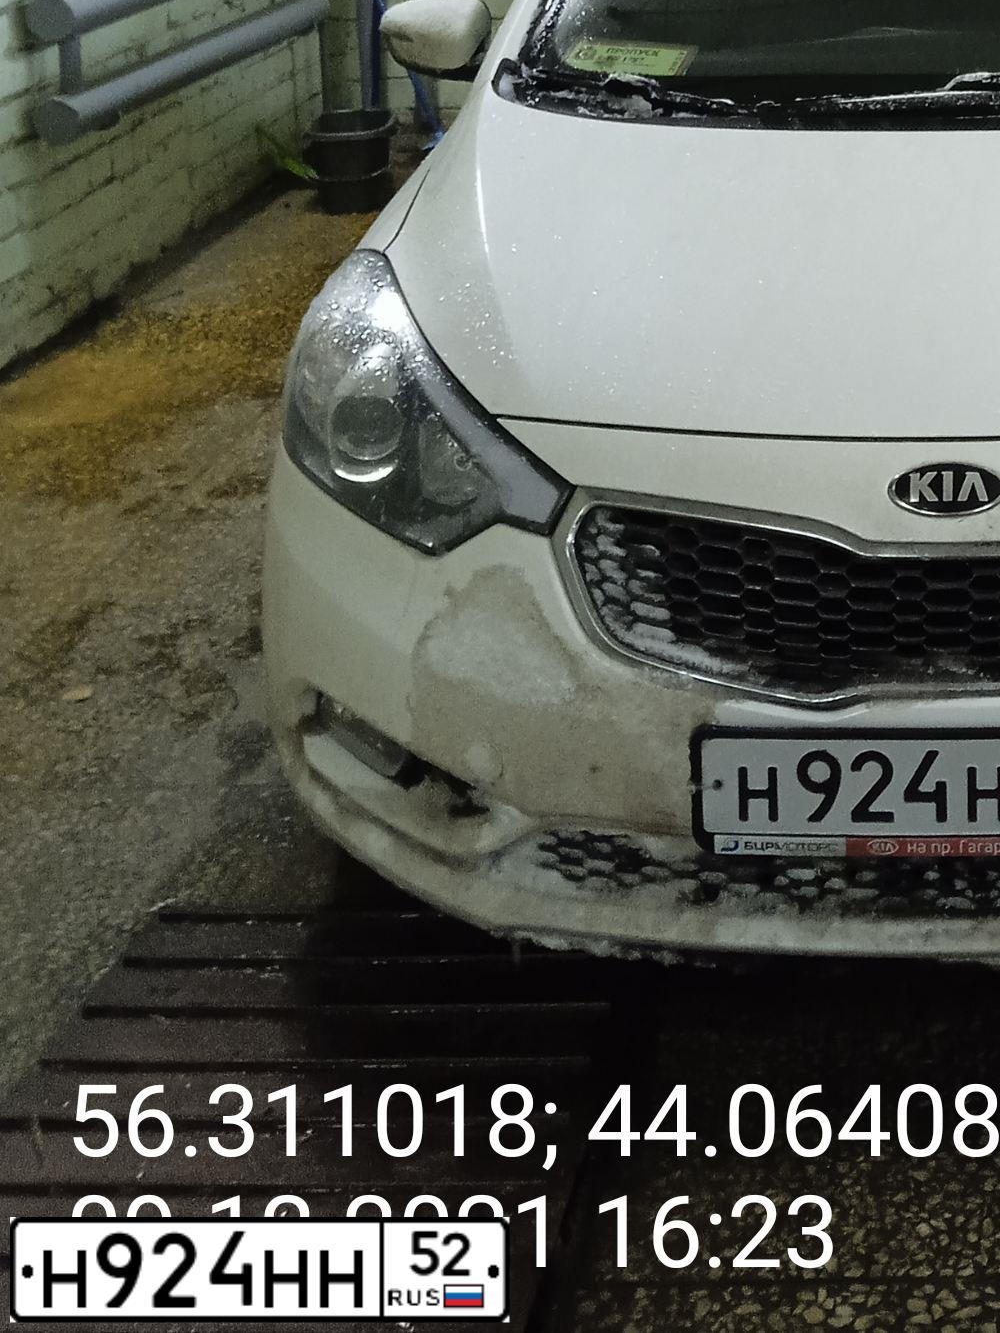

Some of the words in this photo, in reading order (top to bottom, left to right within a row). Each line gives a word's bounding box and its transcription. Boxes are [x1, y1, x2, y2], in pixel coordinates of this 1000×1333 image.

[908, 471, 989, 502] KIA
[907, 843, 926, 853] на
[931, 843, 954, 855] пр.
